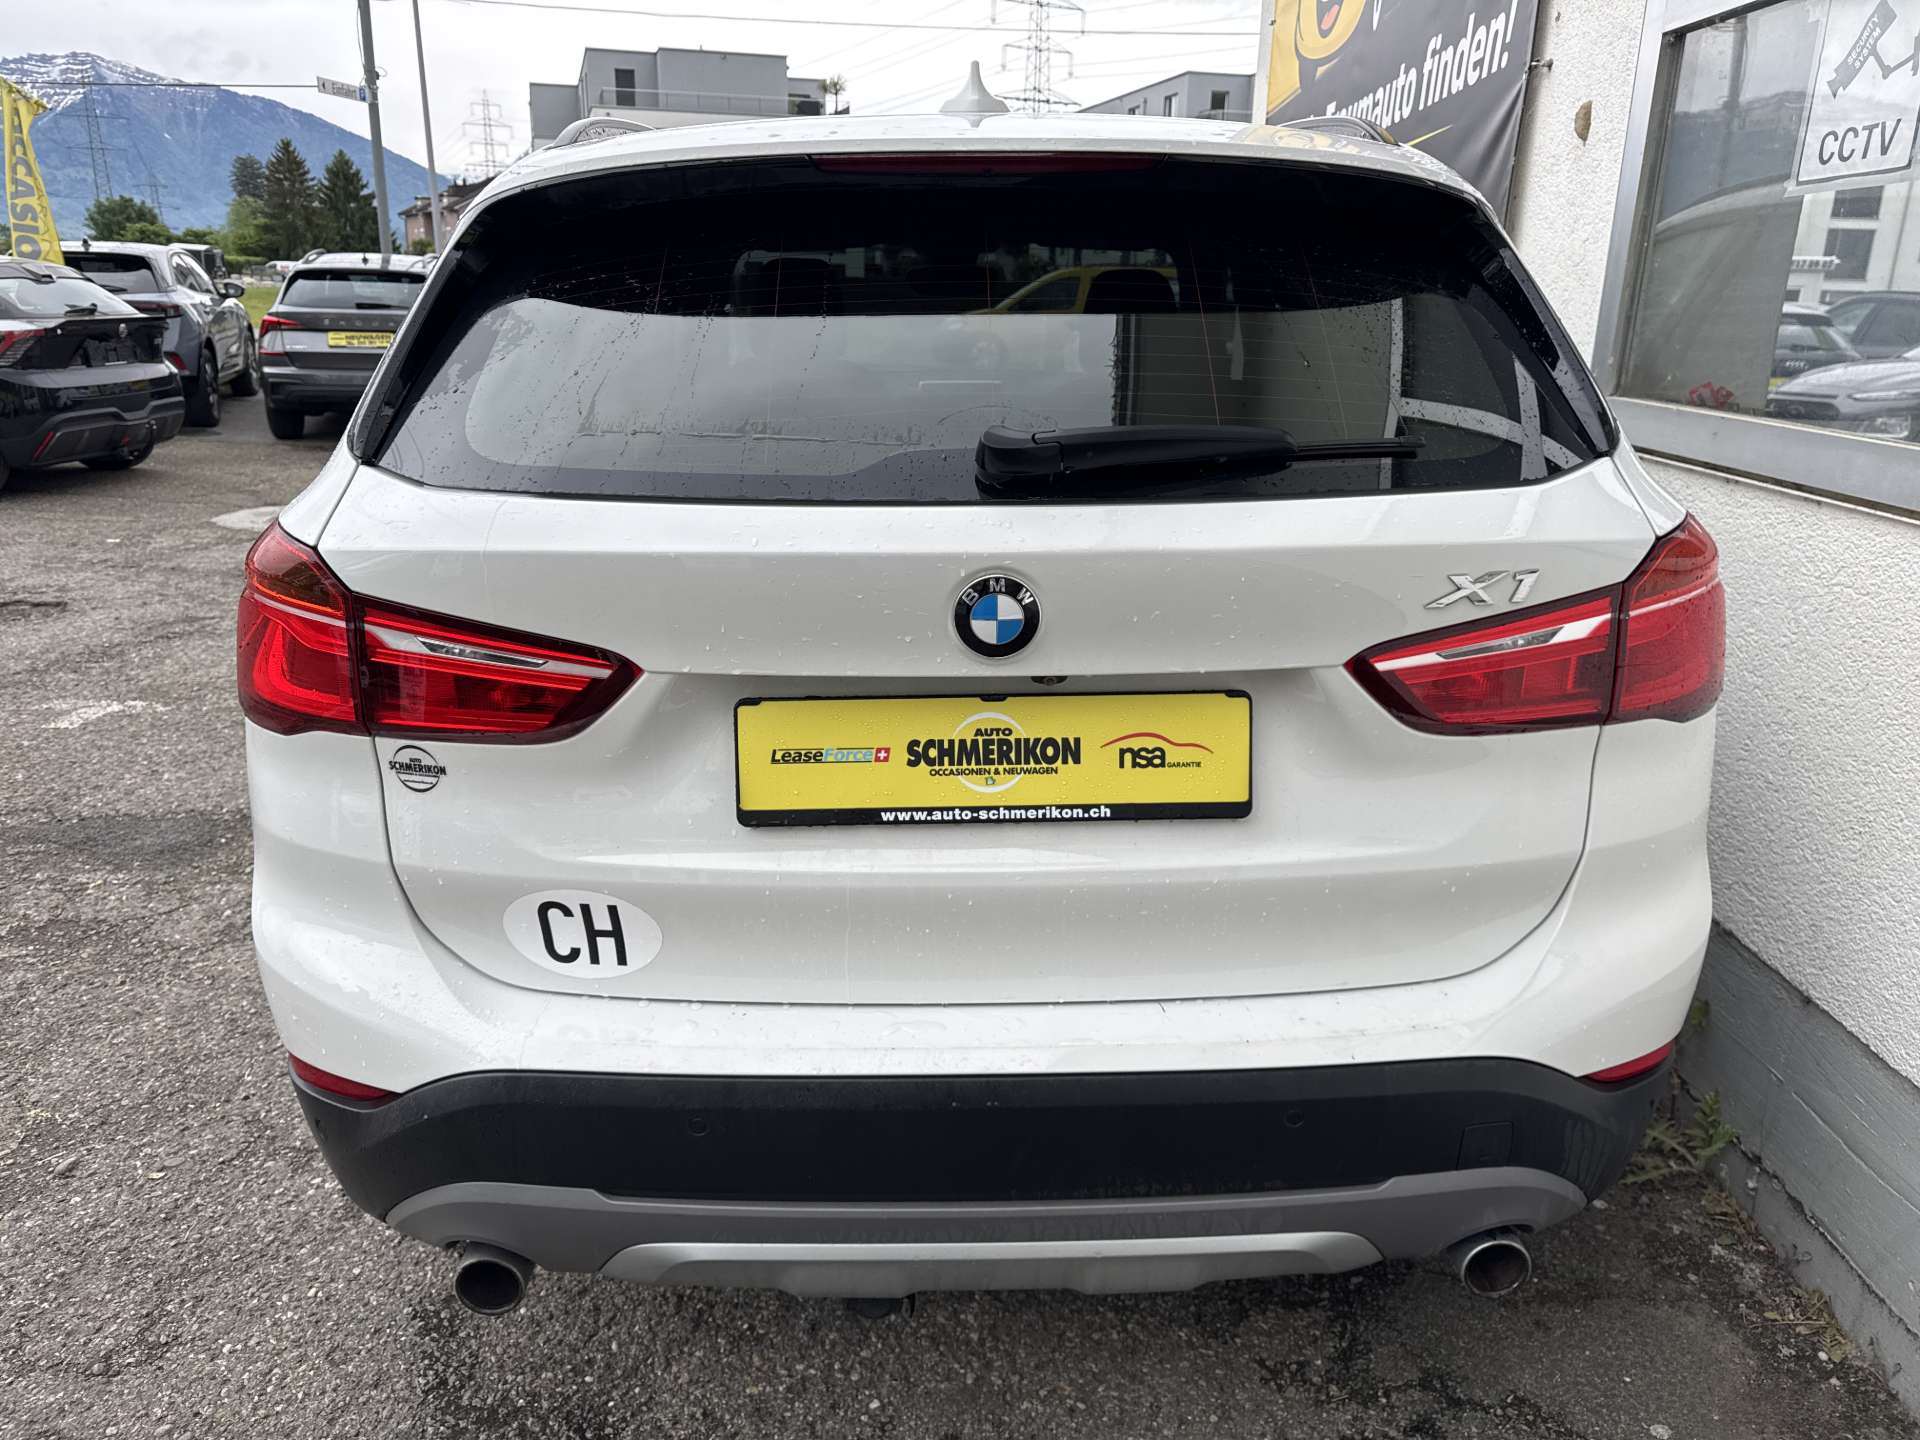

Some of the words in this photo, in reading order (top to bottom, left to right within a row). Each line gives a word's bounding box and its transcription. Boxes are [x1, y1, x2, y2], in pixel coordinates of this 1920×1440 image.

[1847, 14, 1879, 65] SECURITY
[1854, 28, 1882, 69] SYSTEM
[1326, 63, 1416, 128] mauto
[1419, 0, 1518, 110] finden!
[1818, 119, 1902, 166] CCTV
[961, 578, 1035, 607] BMW
[1424, 568, 1540, 608] X1
[974, 728, 1013, 737] AUTO
[771, 748, 873, 764] LeaseForce
[906, 737, 1081, 767] SCHMERIKON
[1118, 747, 1166, 769] nsa
[388, 760, 447, 776] SCHMERIKON
[929, 767, 991, 777] OCCASIONEN
[994, 767, 1001, 776] &
[1003, 766, 1058, 775] NEUWAGEN
[880, 804, 1112, 821] www.auto-schmerikon.ch
[537, 901, 628, 966] CH
